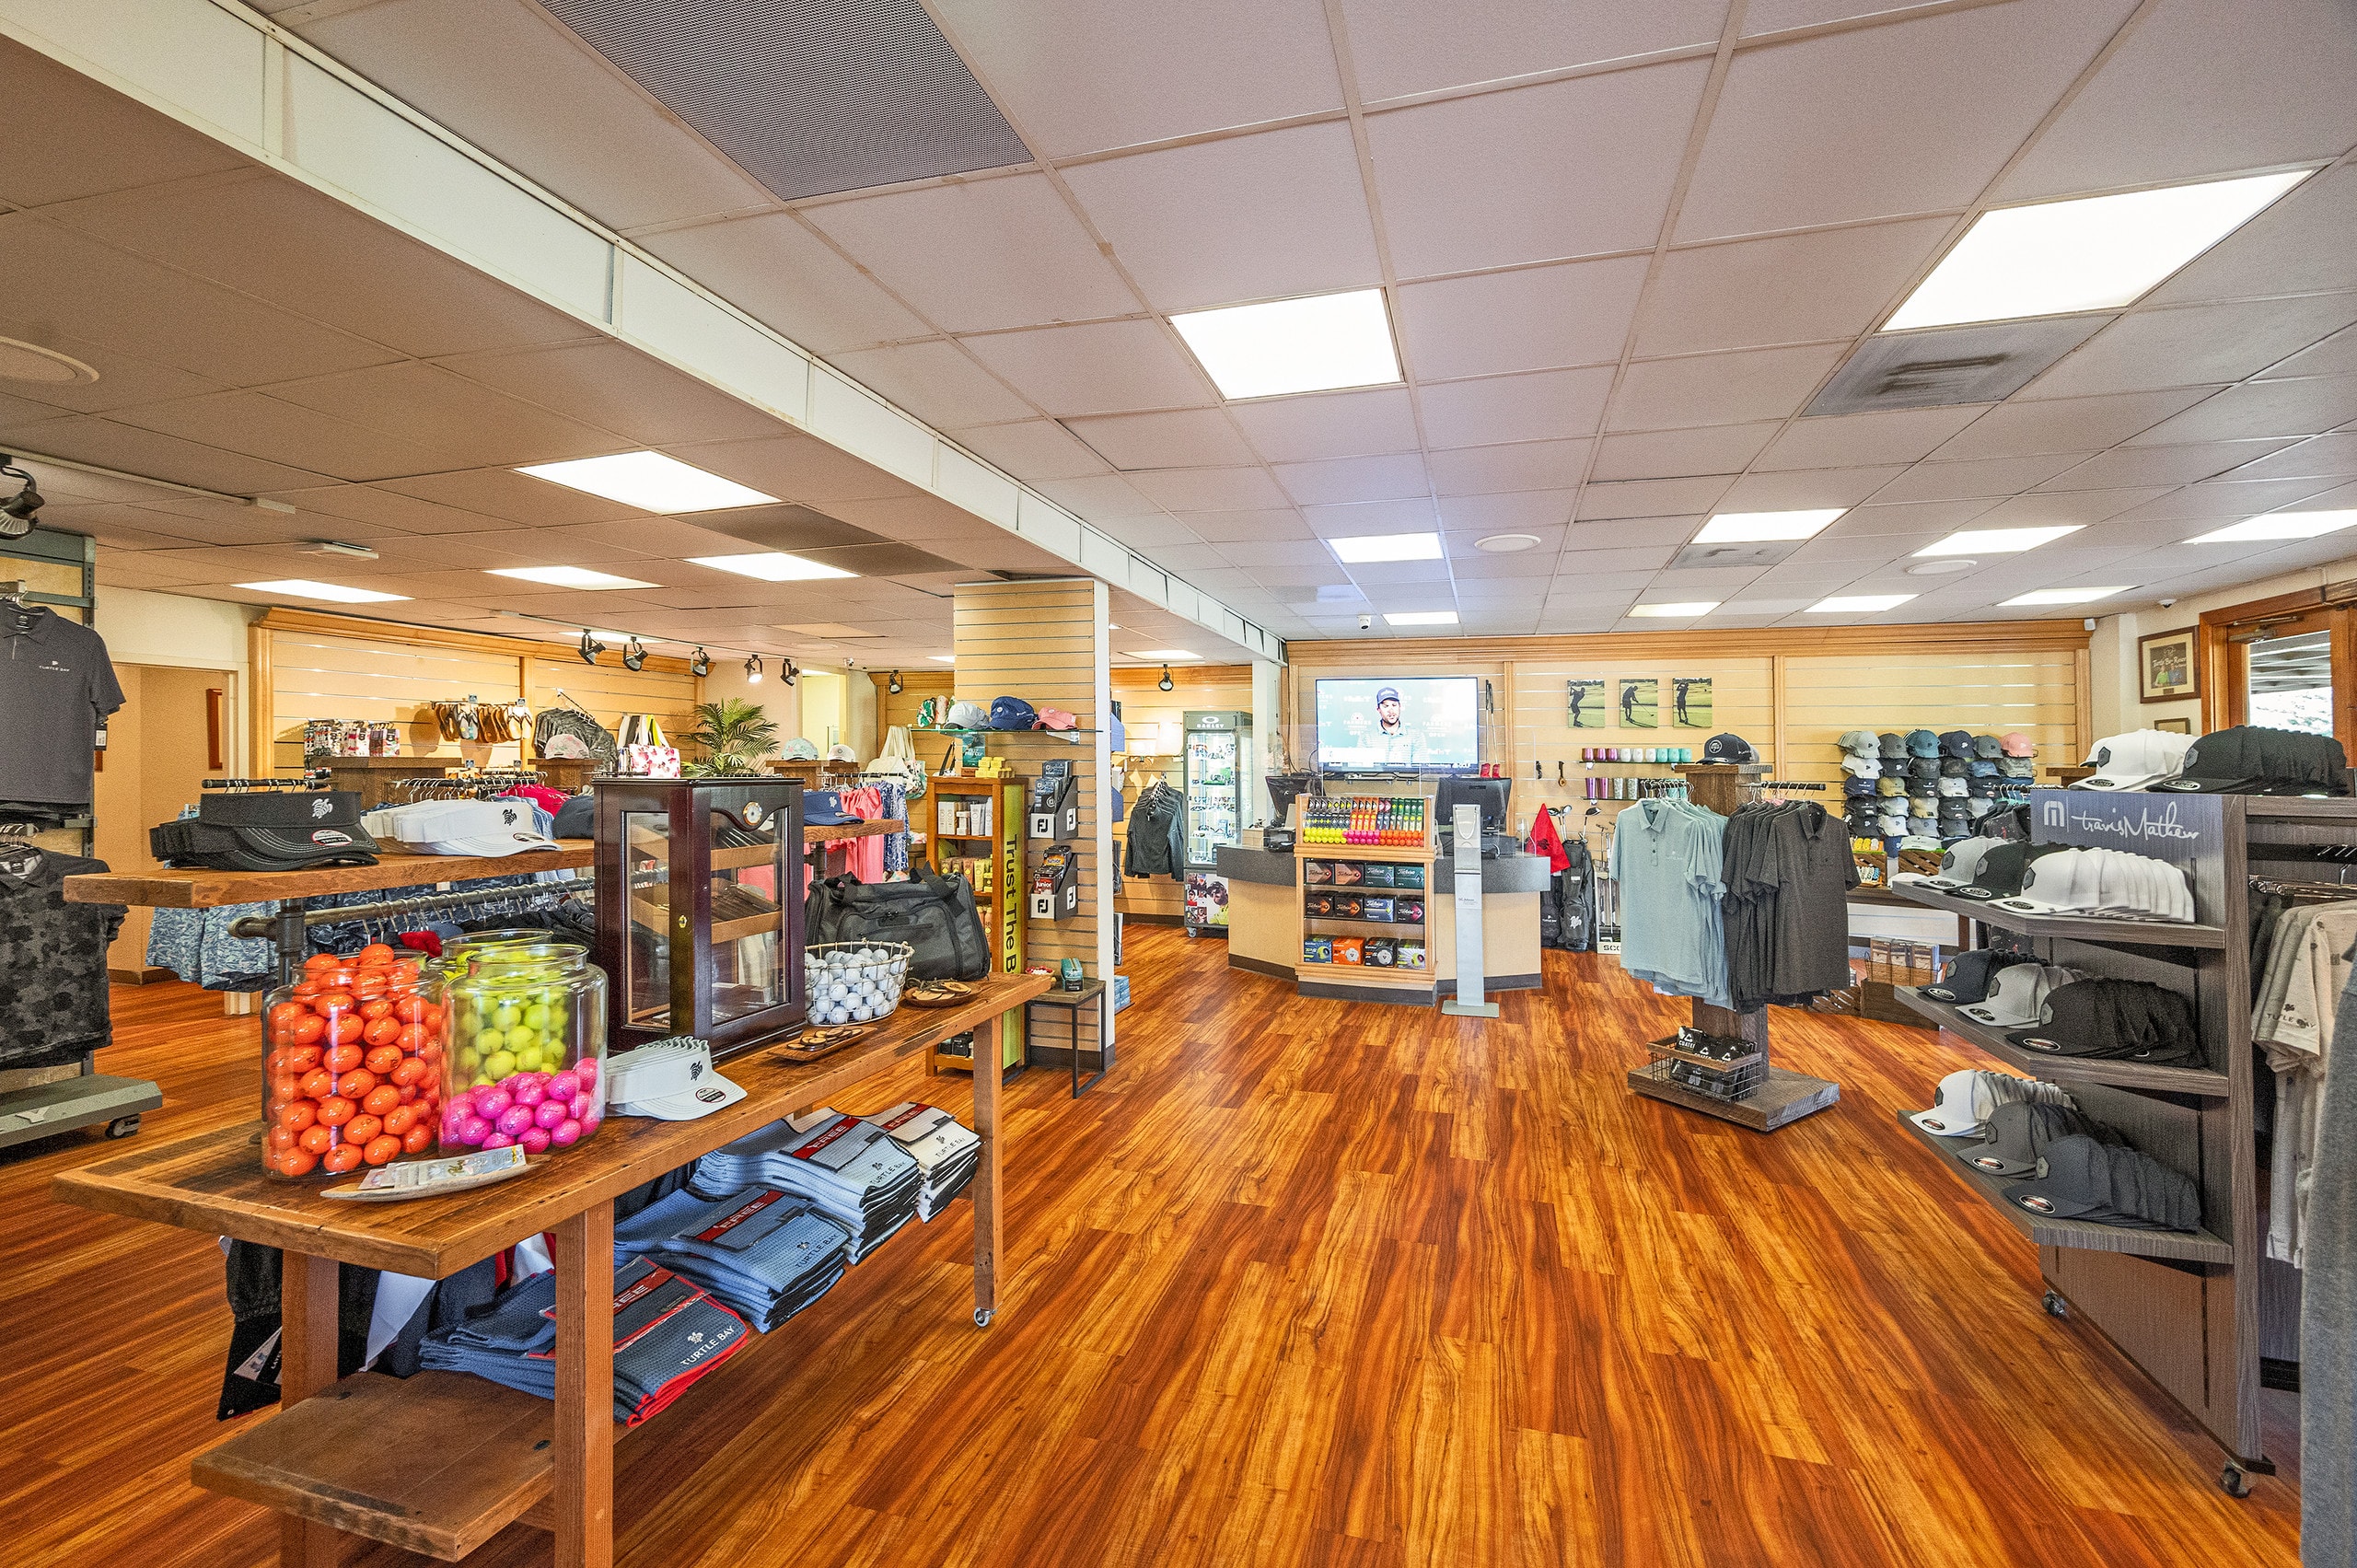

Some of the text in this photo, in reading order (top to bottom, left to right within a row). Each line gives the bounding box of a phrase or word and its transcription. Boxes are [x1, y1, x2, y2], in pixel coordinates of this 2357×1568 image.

[1038, 819, 1048, 832] FJ
[1006, 834, 1016, 899] Trust
[1038, 899, 1048, 913] FJ
[1006, 902, 1016, 949] The
[809, 1125, 847, 1148] FREE
[795, 1235, 838, 1268] TURTLE BAY
[613, 1284, 648, 1308] REE
[679, 1325, 735, 1365] TURTLE BAY
